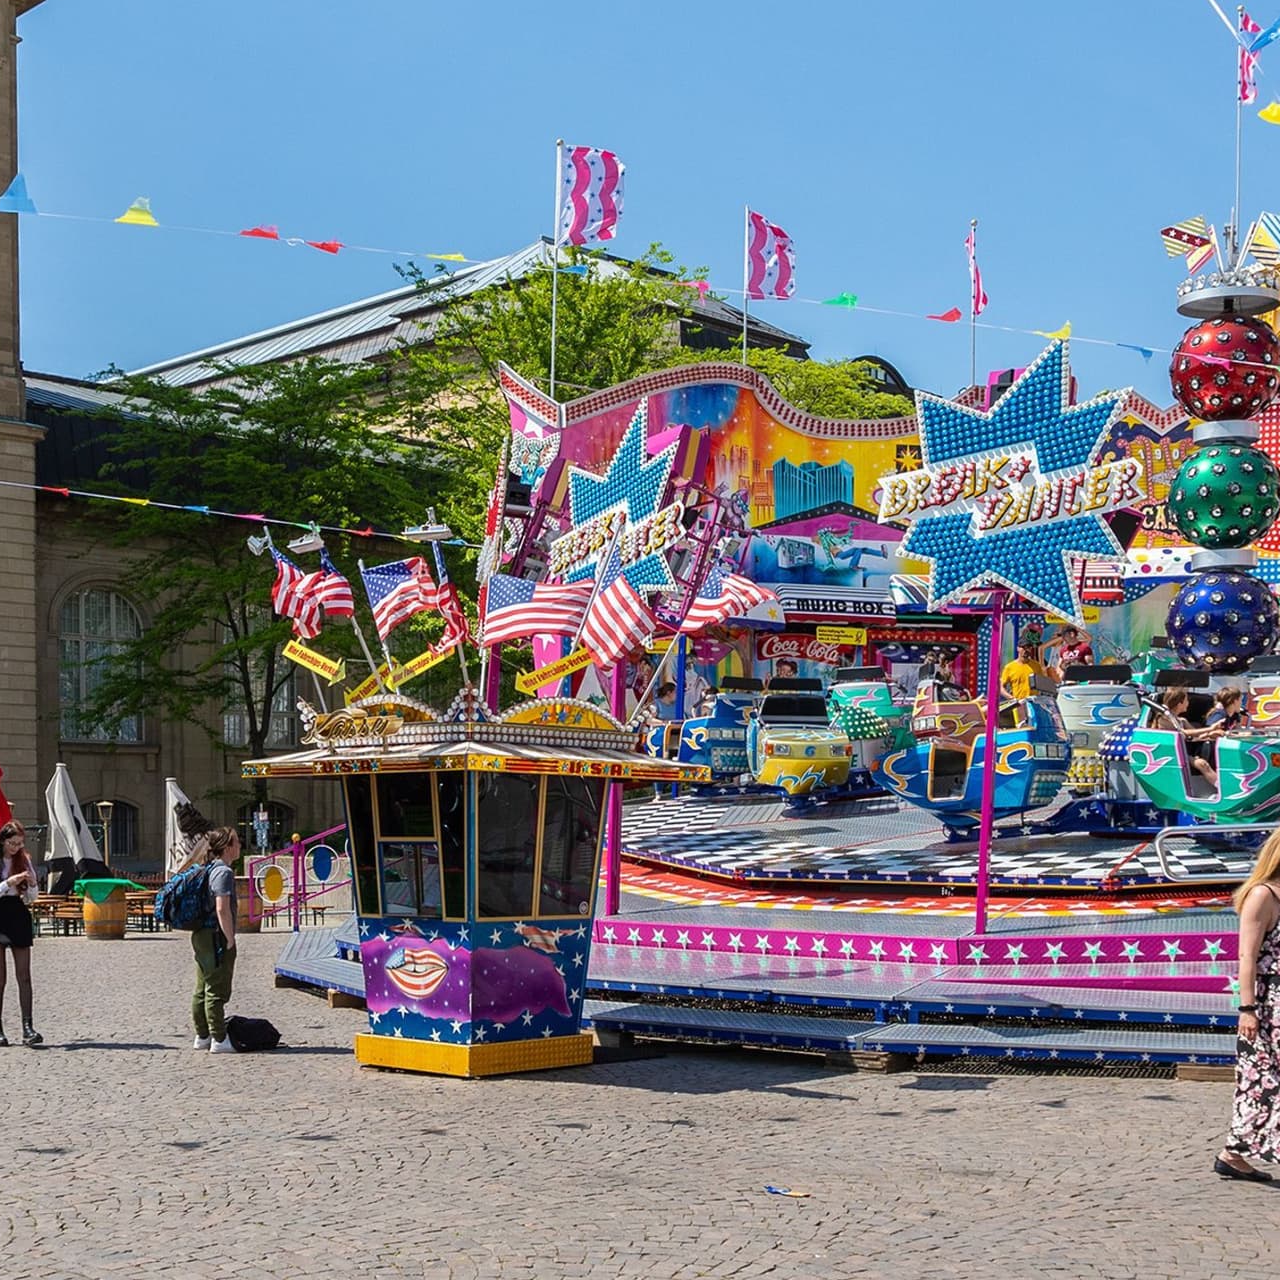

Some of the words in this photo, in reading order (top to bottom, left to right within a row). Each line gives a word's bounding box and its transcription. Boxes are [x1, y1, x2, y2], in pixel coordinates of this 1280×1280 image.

[883, 455, 1011, 518] BREAK
[976, 462, 1141, 531] DANCER
[804, 745, 817, 757] 6
